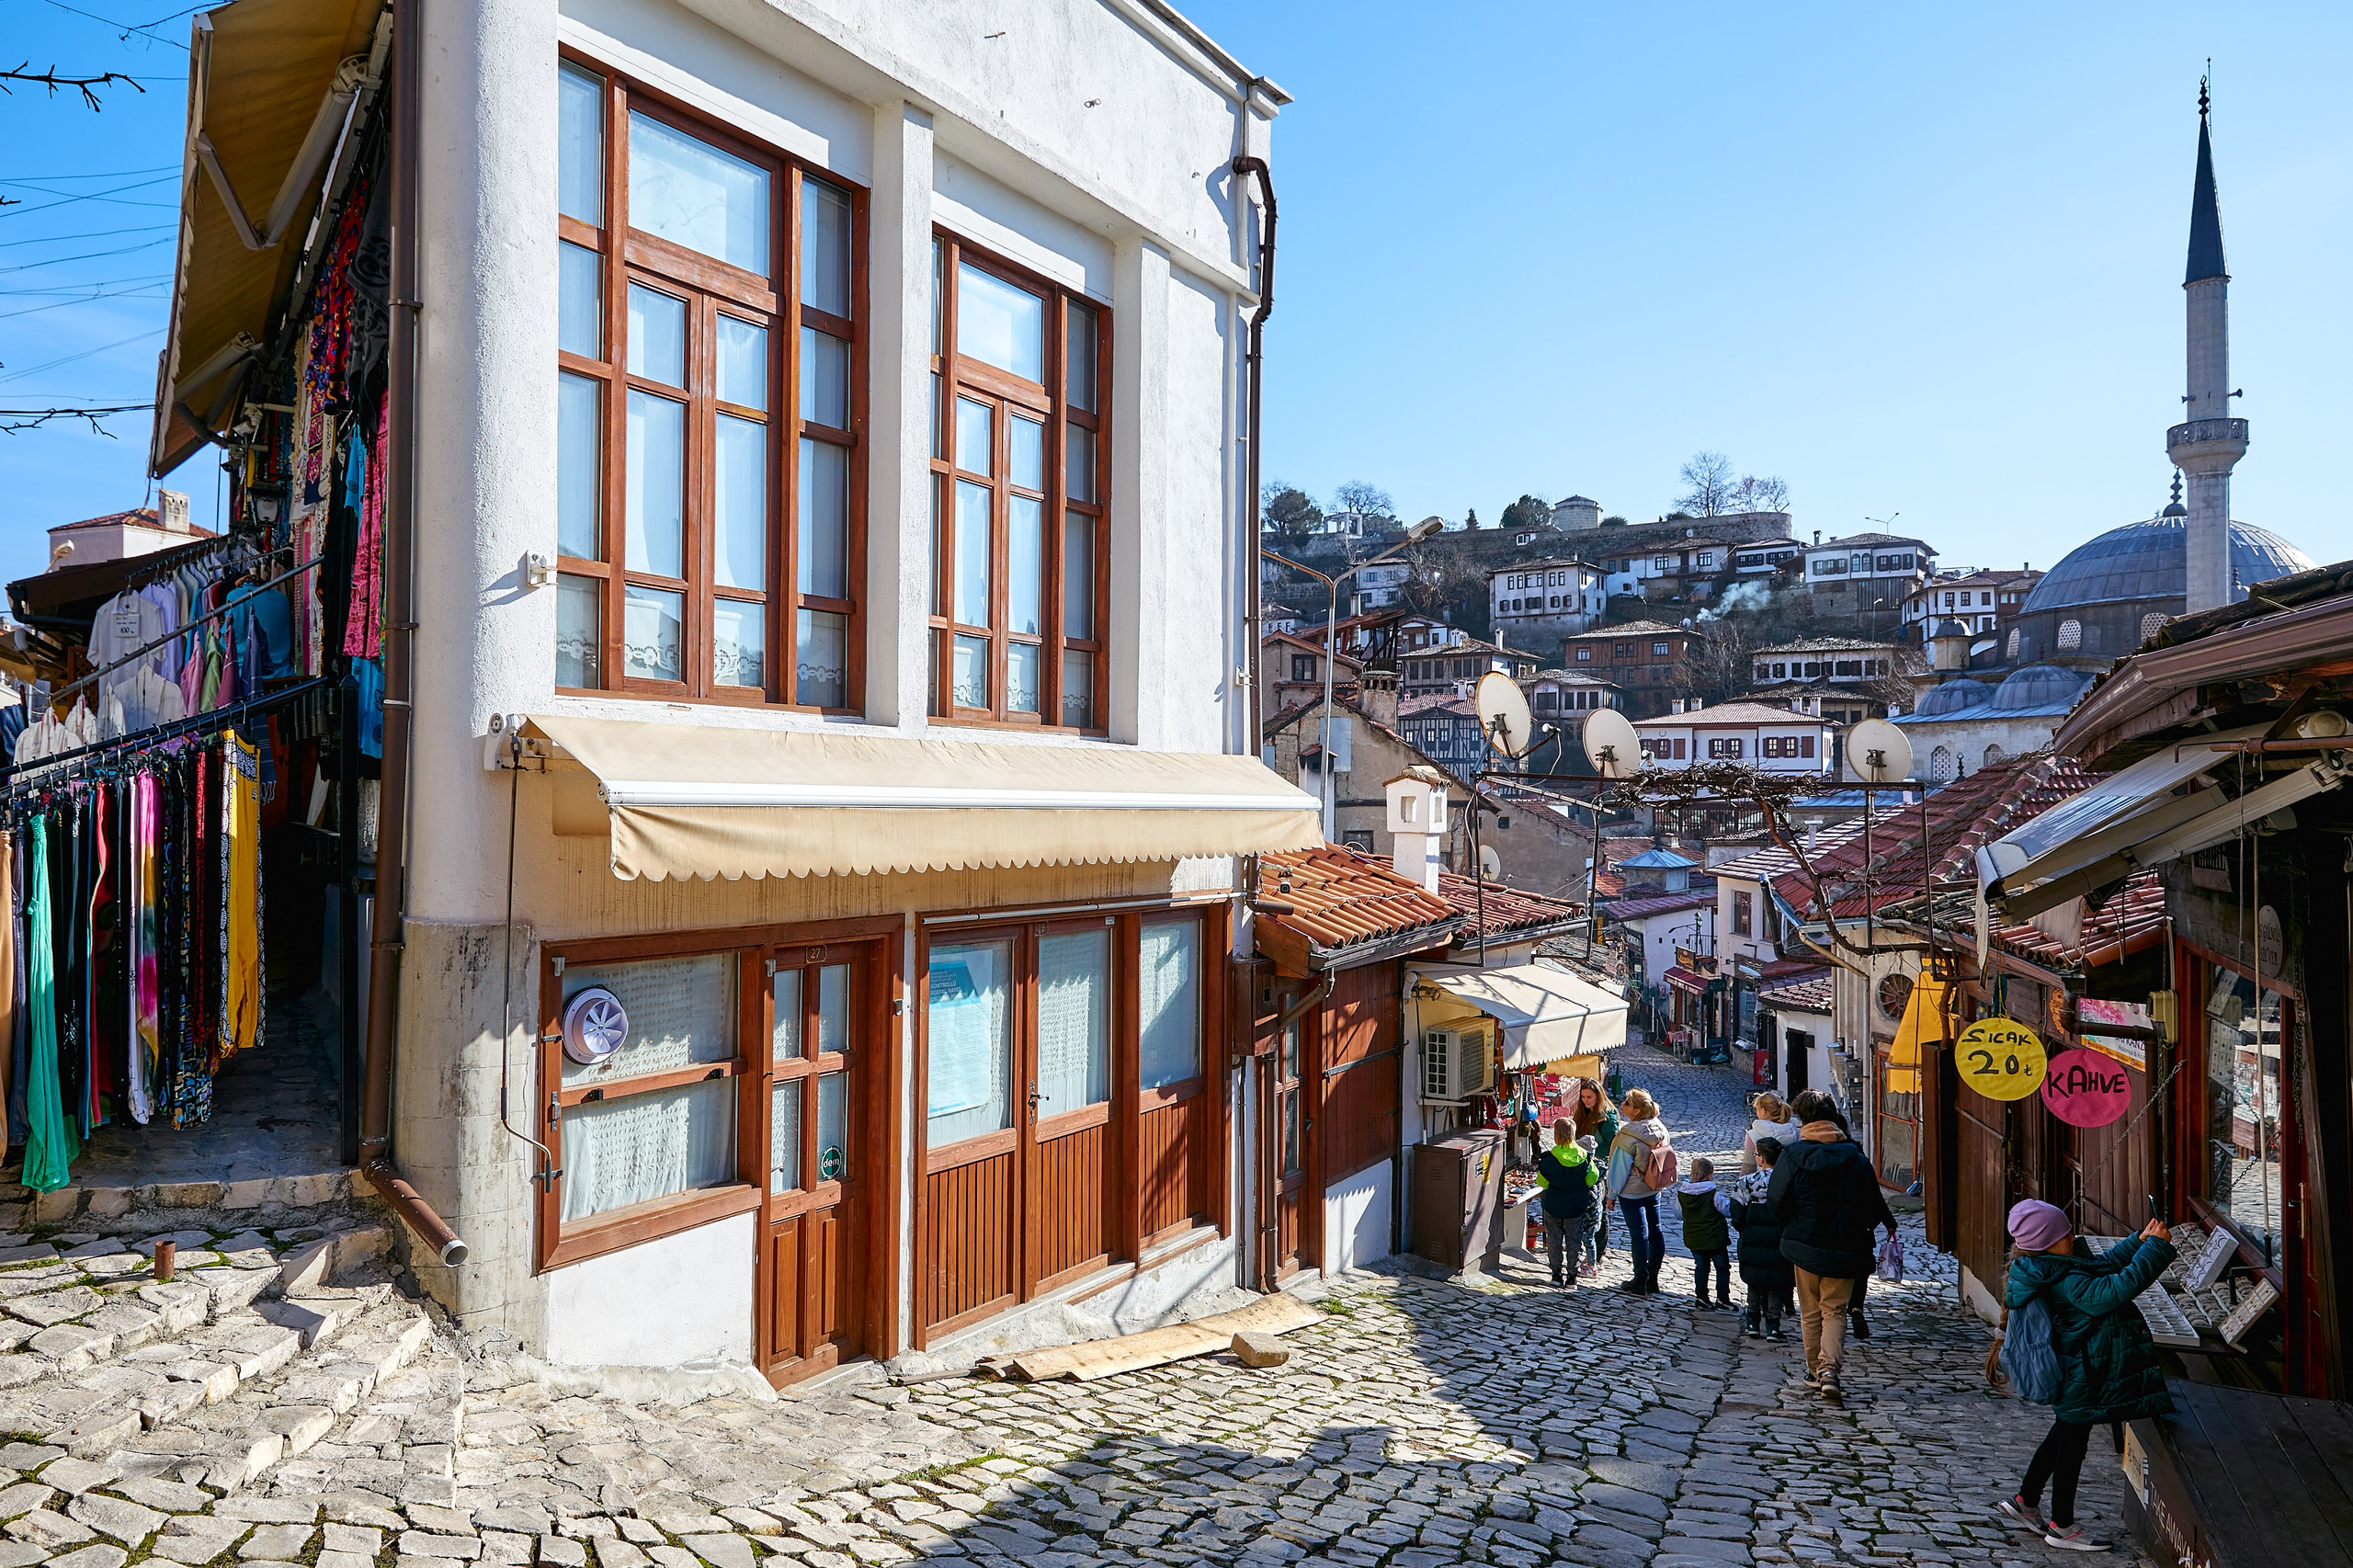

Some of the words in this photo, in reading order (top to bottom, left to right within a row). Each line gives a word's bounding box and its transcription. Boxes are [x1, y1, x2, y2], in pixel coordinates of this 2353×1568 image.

[810, 948, 821, 959] 27
[1961, 1028, 2031, 1046] SICAK
[2047, 1065, 2125, 1098] KAHVE
[824, 1158, 839, 1168] dem
[2150, 1481, 2166, 1529] TAKE
[2165, 1513, 2187, 1559] AWAY
